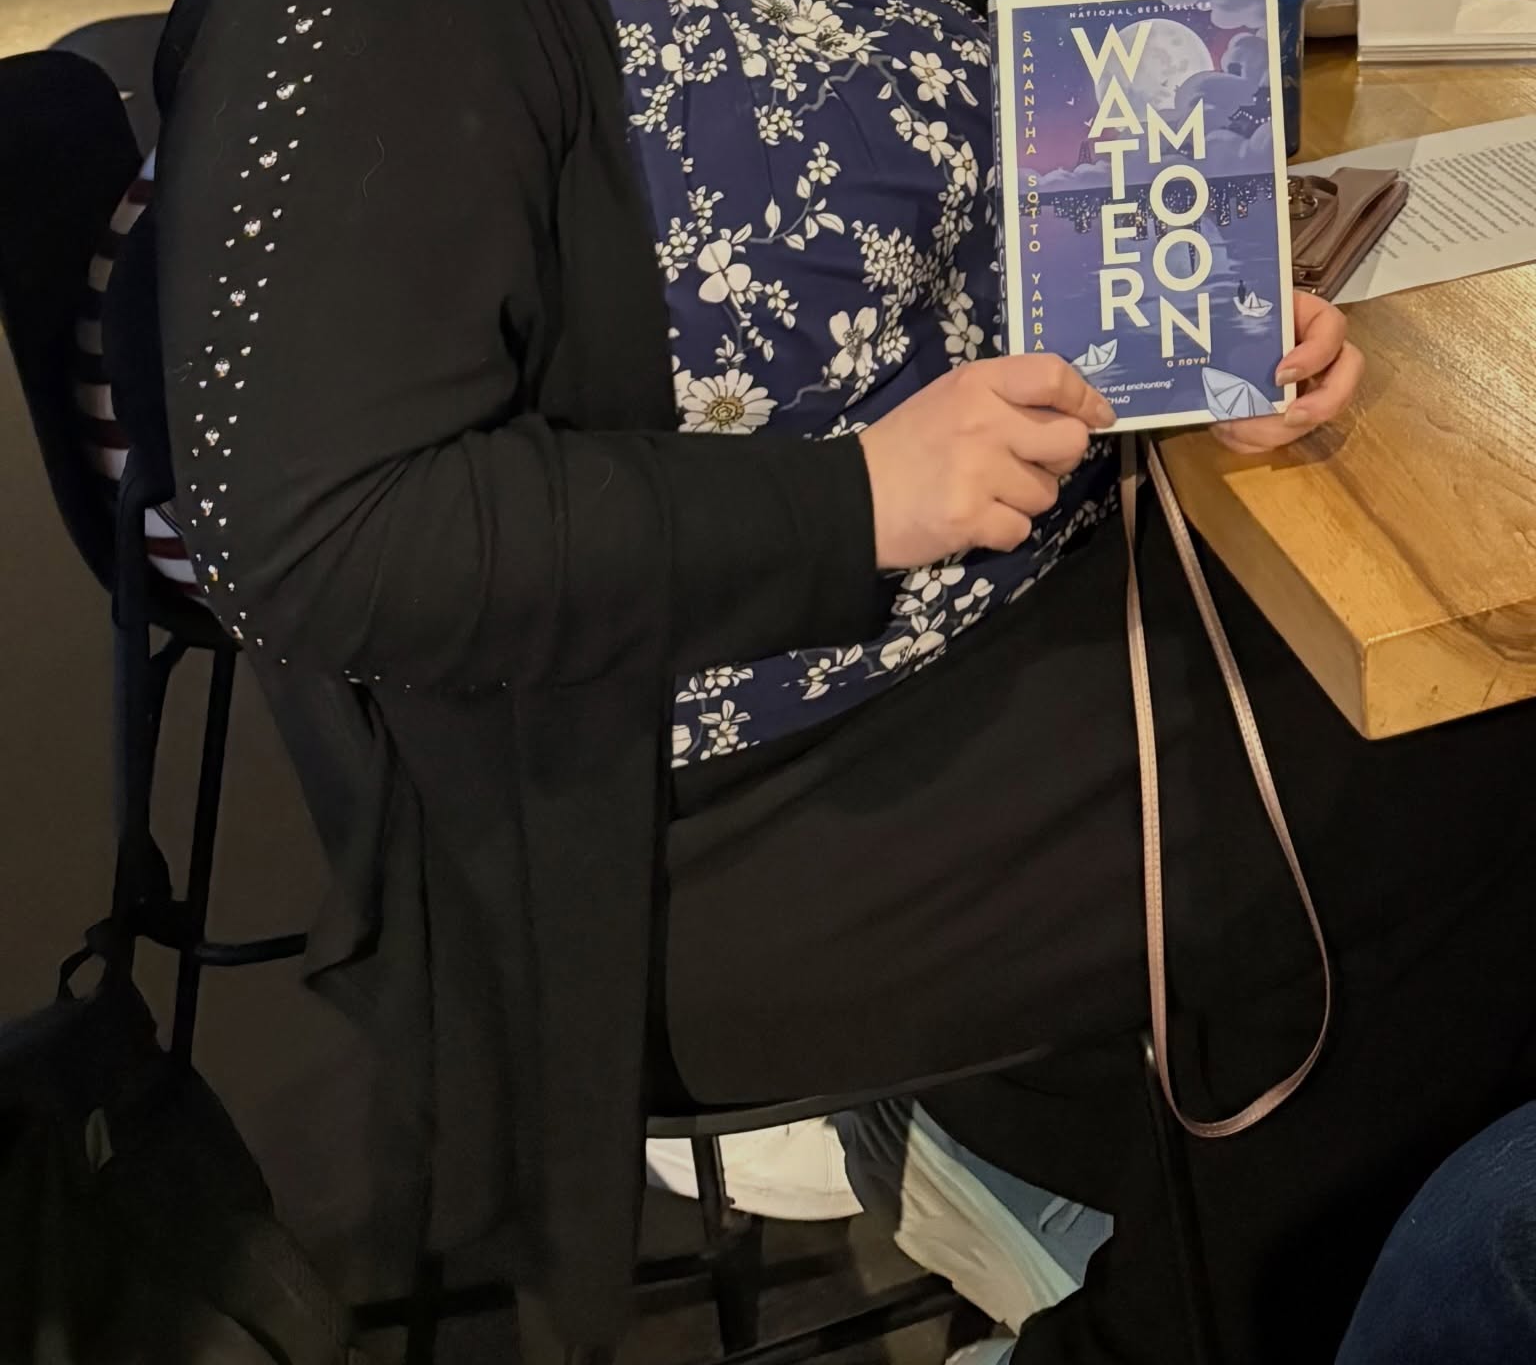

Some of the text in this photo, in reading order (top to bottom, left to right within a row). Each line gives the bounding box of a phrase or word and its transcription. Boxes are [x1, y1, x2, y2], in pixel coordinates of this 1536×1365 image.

[1069, 1, 1212, 19] NATIONAL BESTSELLER
[1022, 30, 1038, 156] SAMANTHA
[1026, 175, 1042, 254] SOTTO
[1071, 21, 1152, 331] WATER
[1146, 98, 1213, 358] MOON
[1031, 272, 1045, 353] YAMBA
[1109, 383, 1126, 393] and
[1179, 355, 1211, 367] novel
